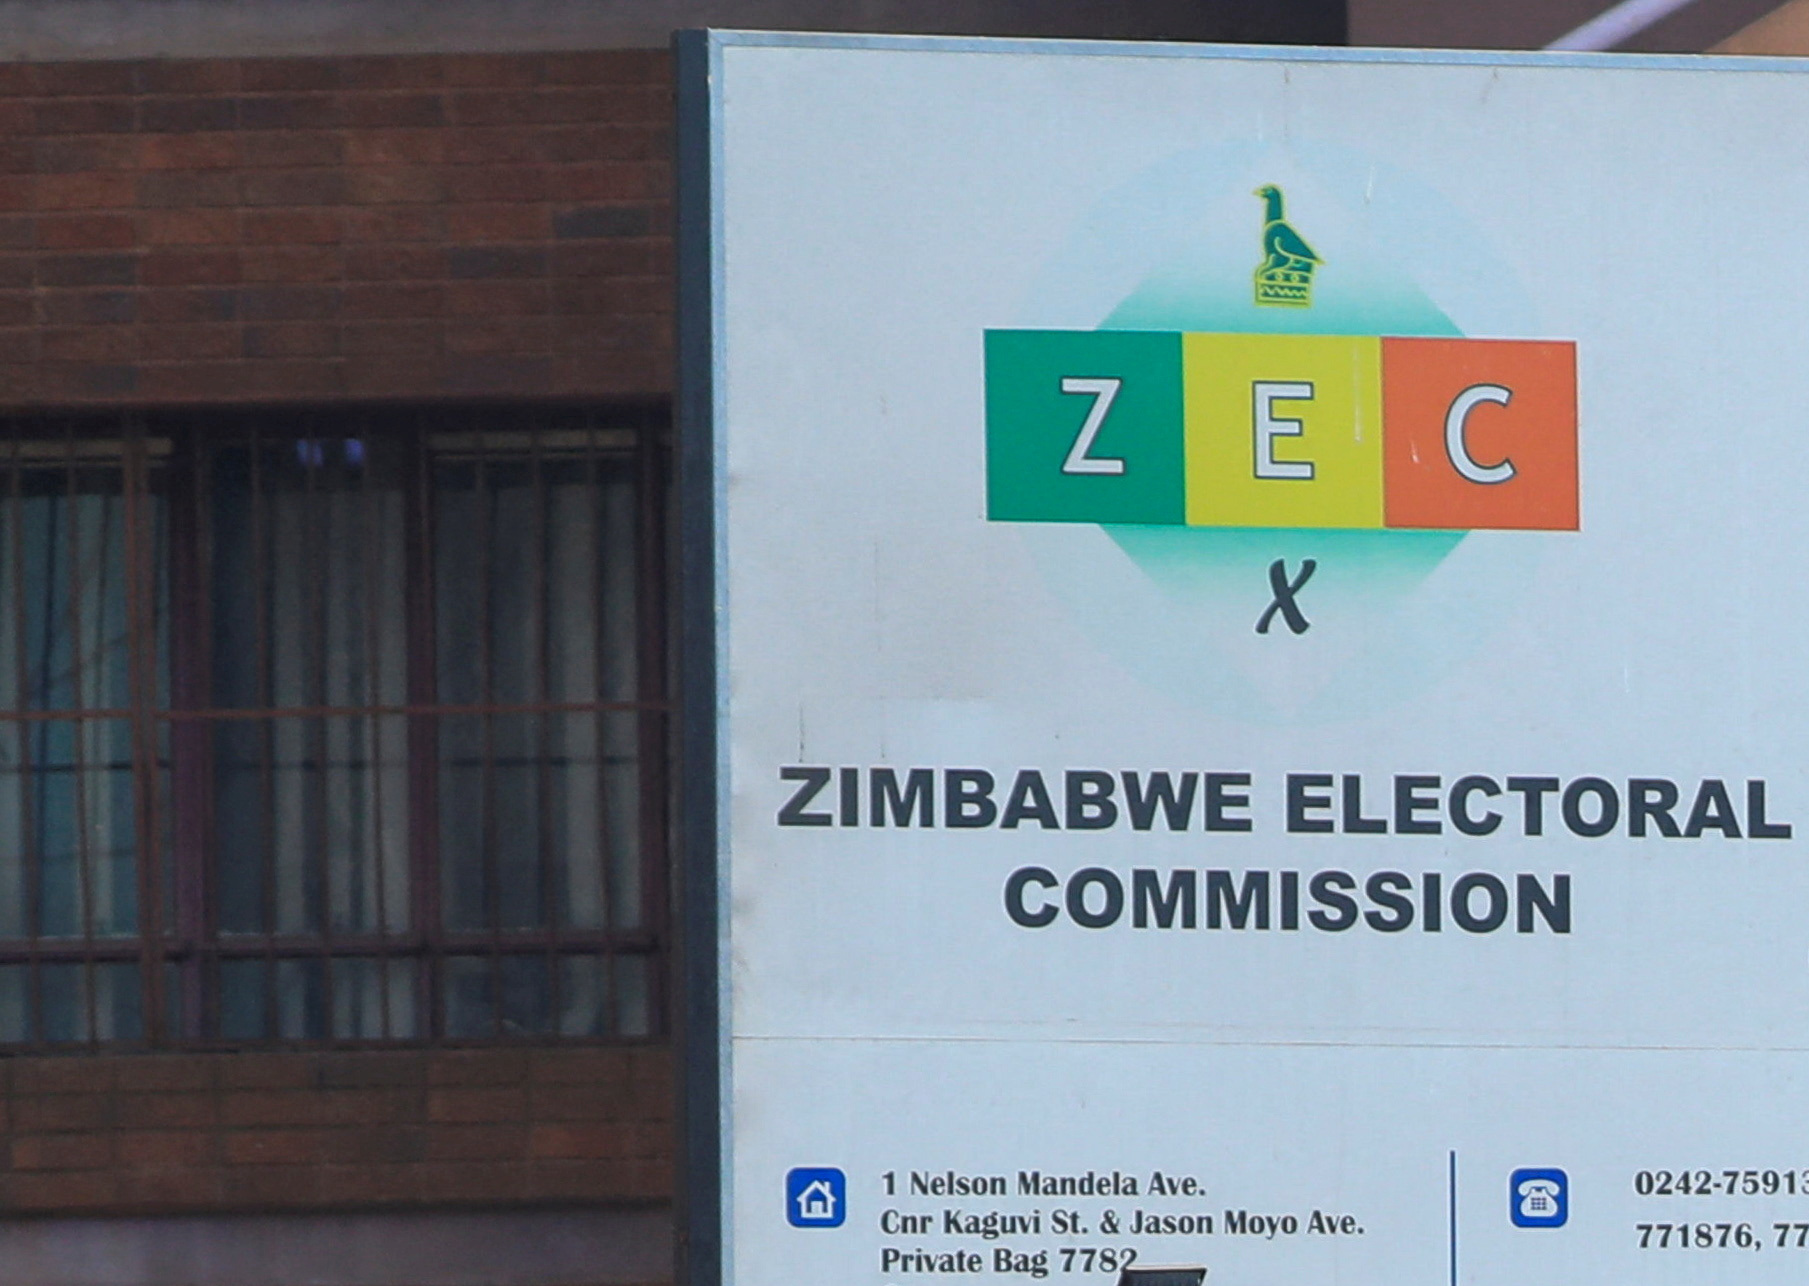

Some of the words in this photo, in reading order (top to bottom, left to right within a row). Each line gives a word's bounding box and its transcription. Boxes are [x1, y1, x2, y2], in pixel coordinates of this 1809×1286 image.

[777, 766, 1253, 833] ZIMBABWE
[1286, 773, 1793, 840] ELECTORAL
[1003, 866, 1571, 934] COMMISSION
[881, 1171, 896, 1196] 1
[910, 1171, 1007, 1196] Nelson
[1017, 1171, 1139, 1196] Mandela
[1148, 1171, 1206, 1196] Ave.
[880, 1209, 933, 1235] Cnr
[944, 1209, 1041, 1240] Kaguvi
[1051, 1209, 1089, 1235] St.
[1099, 1209, 1120, 1235] &
[1129, 1209, 1213, 1236] Jason
[1224, 1209, 1298, 1240] Moyo
[1307, 1209, 1365, 1235] Ave.
[1635, 1223, 1762, 1251] 771876,
[881, 1247, 983, 1273] Private
[993, 1247, 1049, 1279] Bag
